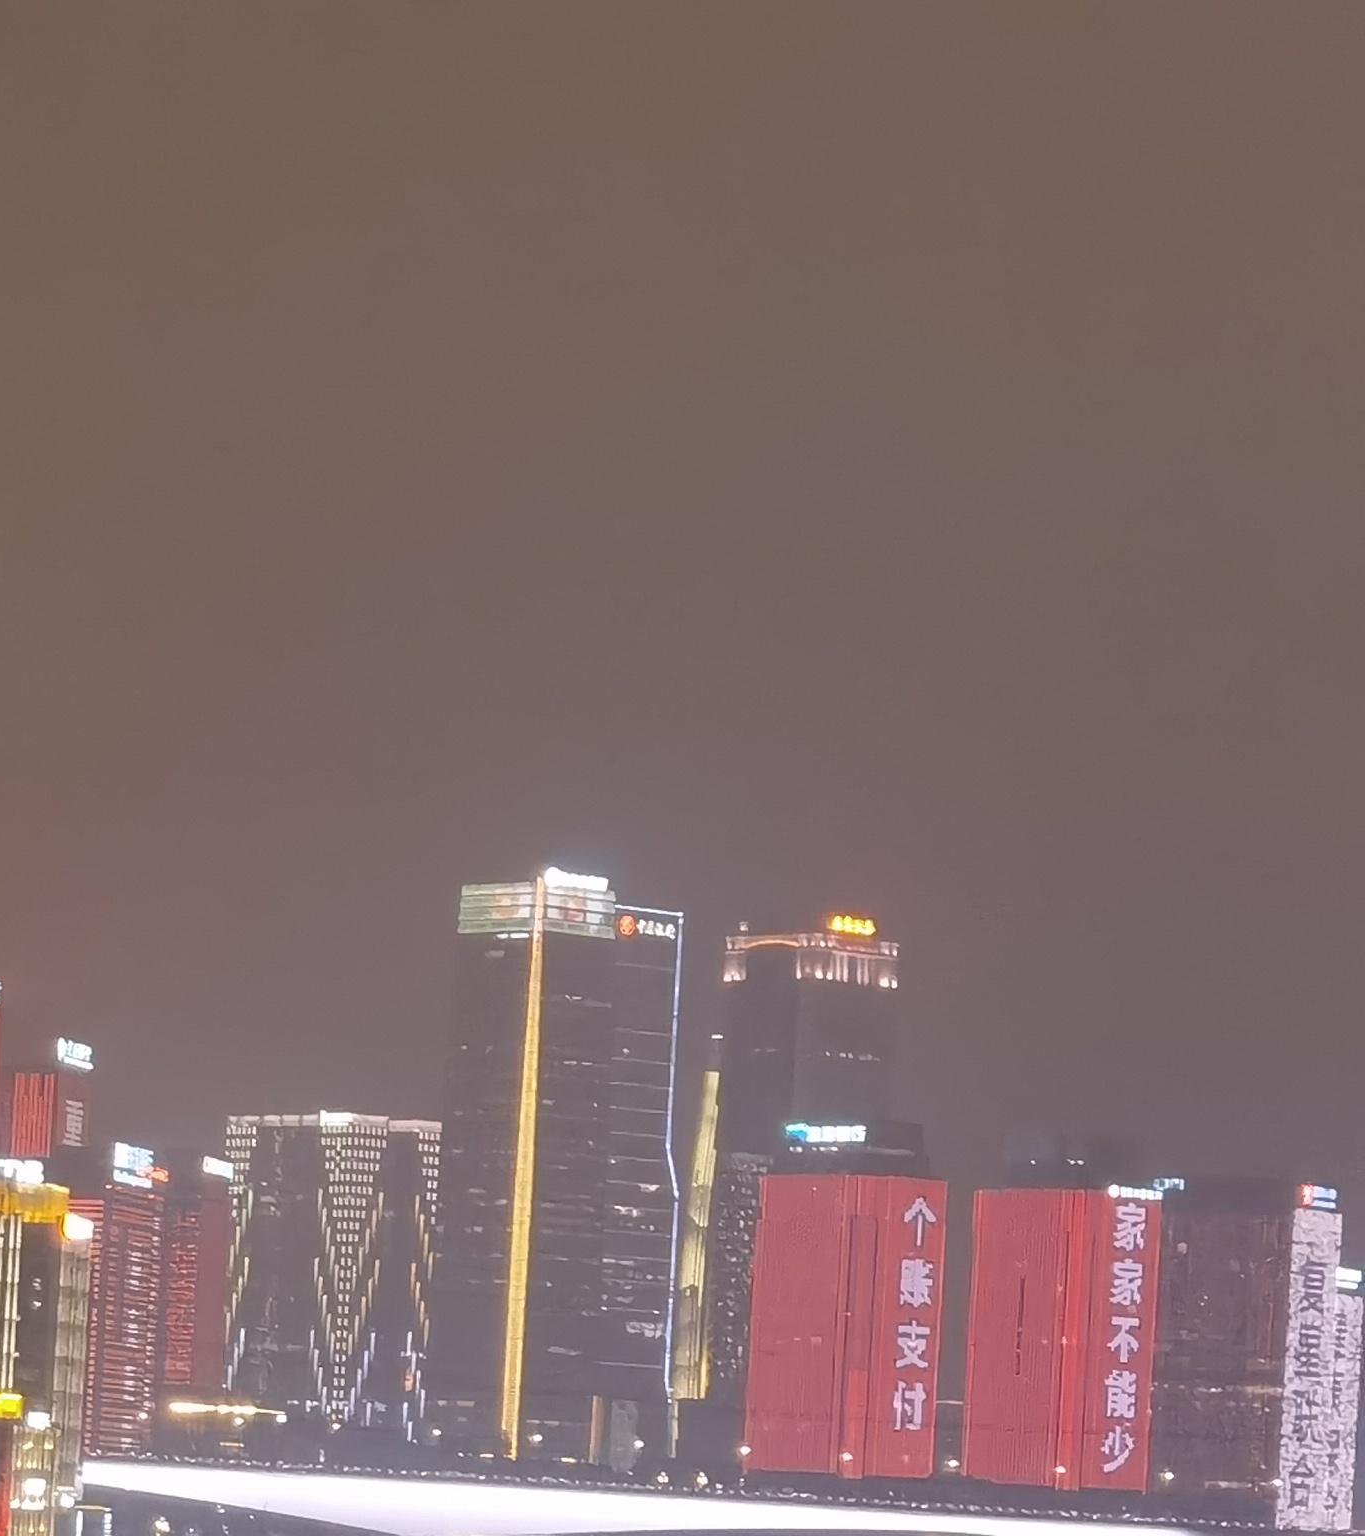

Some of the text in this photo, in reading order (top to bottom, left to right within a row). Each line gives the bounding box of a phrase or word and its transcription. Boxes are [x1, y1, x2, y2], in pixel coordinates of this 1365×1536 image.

[893, 1196, 937, 1432] 个账支付
[1099, 1202, 1147, 1474] 家家不能少
